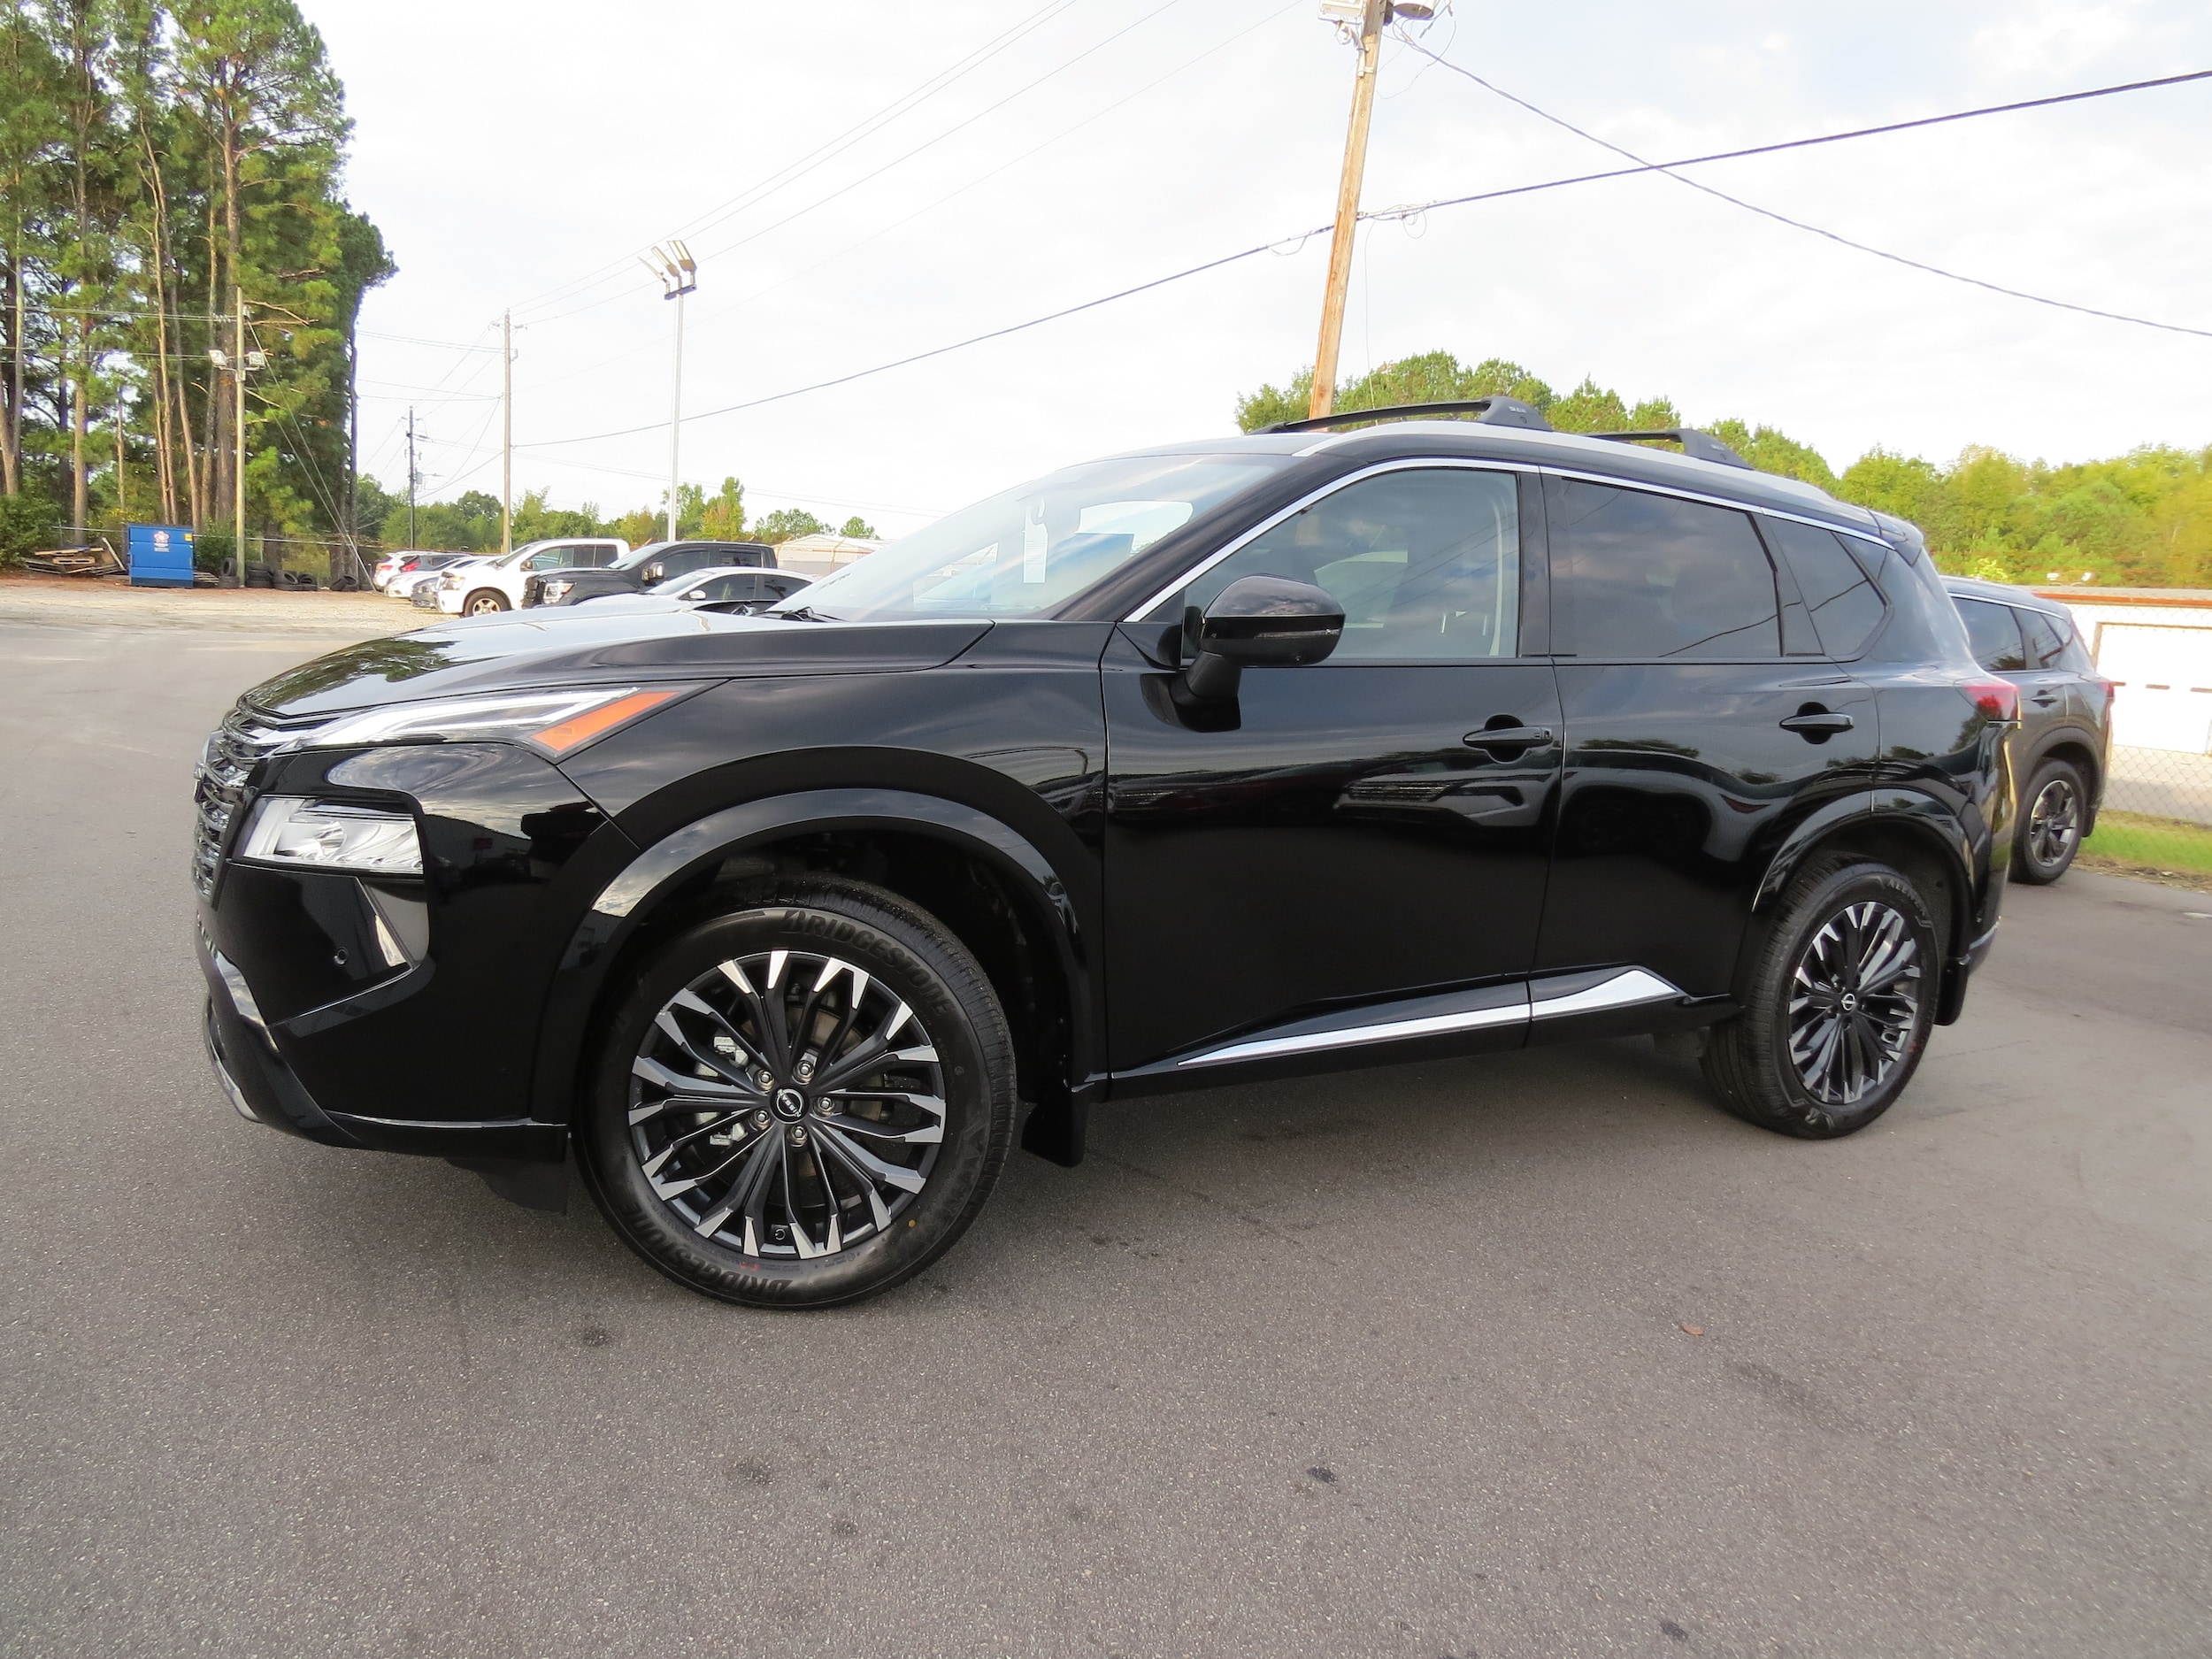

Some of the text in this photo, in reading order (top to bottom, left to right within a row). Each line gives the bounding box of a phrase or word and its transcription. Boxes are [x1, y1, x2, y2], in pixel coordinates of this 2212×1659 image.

[780, 909, 956, 1015] BRIDGESTONE
[776, 1088, 803, 1118] NISSAN
[618, 1202, 794, 1302] BRIDGESTONE
